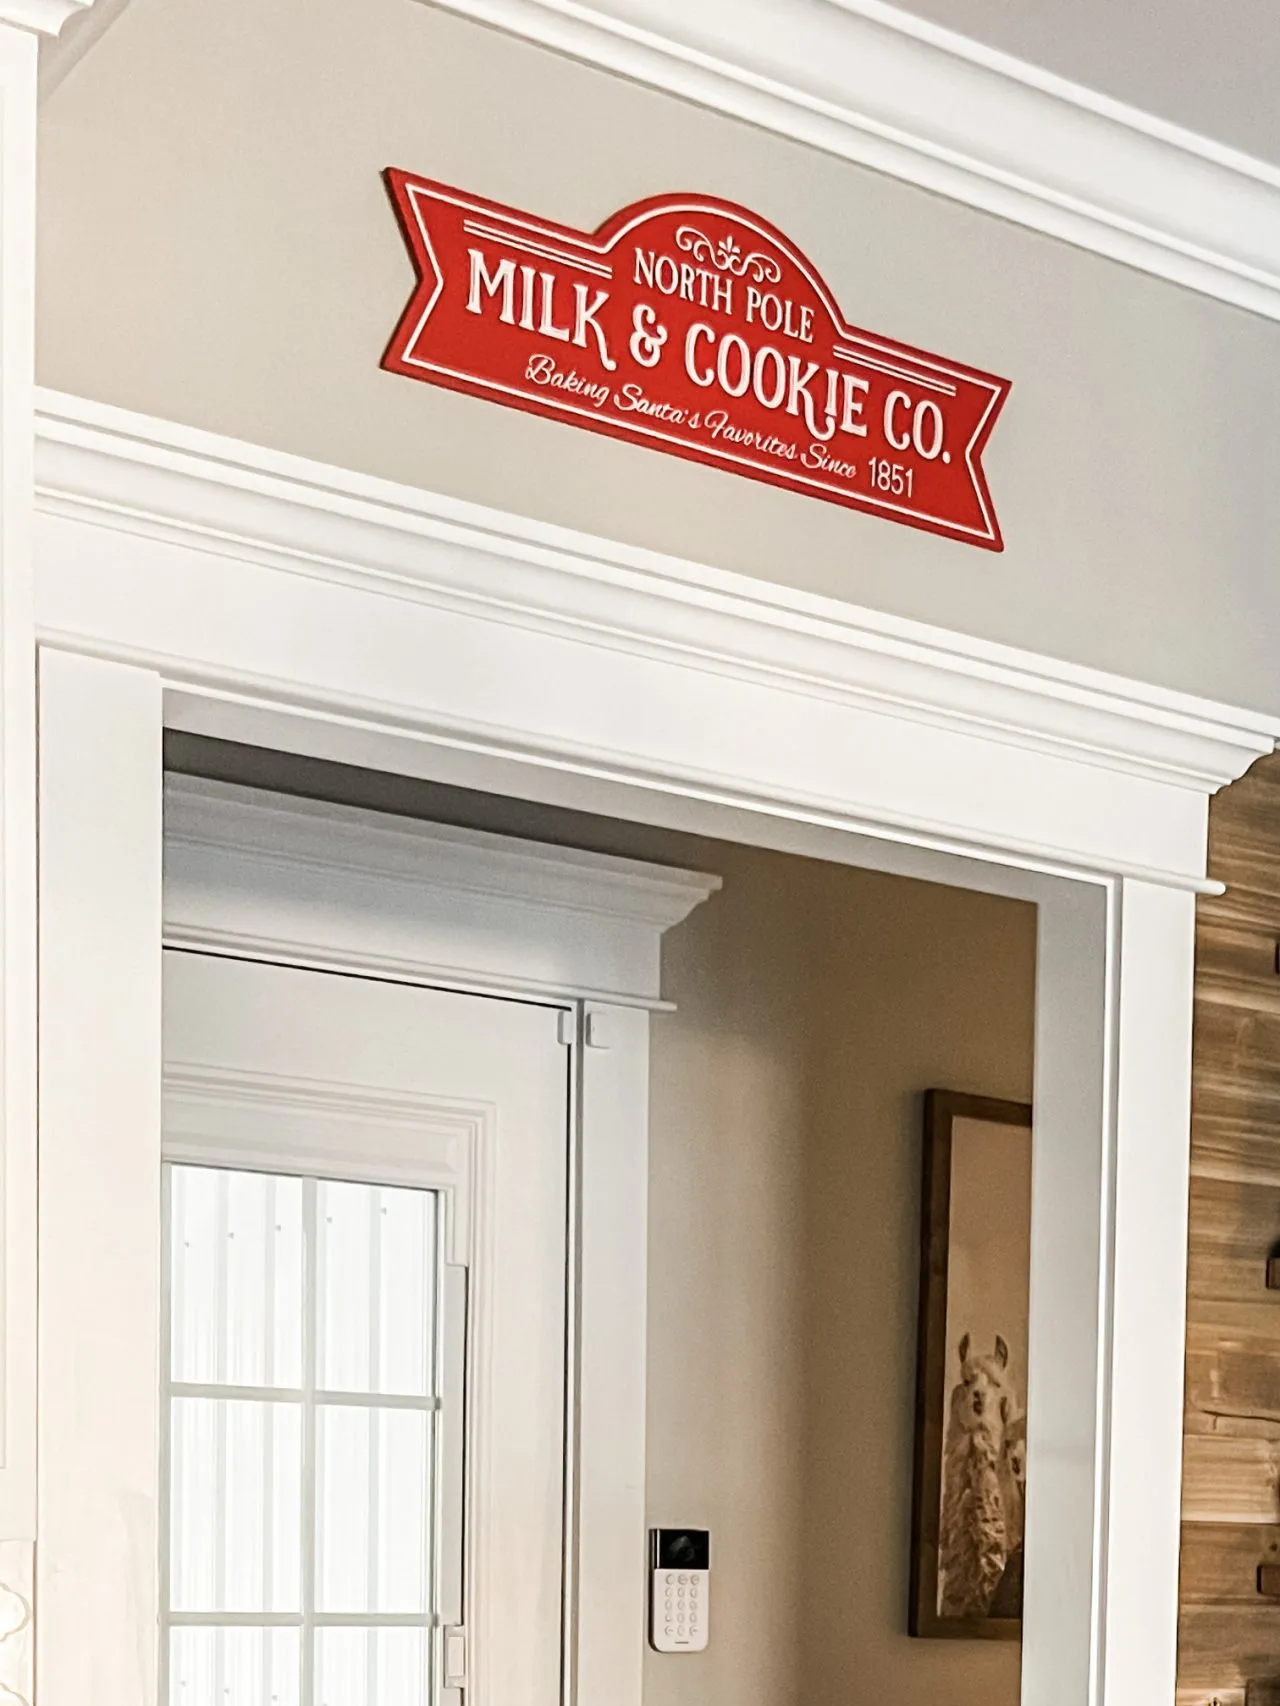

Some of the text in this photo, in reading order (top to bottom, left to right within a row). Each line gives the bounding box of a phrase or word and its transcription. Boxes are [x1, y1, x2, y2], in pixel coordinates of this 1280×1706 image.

[465, 248, 951, 464] MILK & COOKIE CO.
[632, 247, 815, 344] NORTH POLE
[525, 354, 914, 498] Baking Santa's Favorites Since 1851
